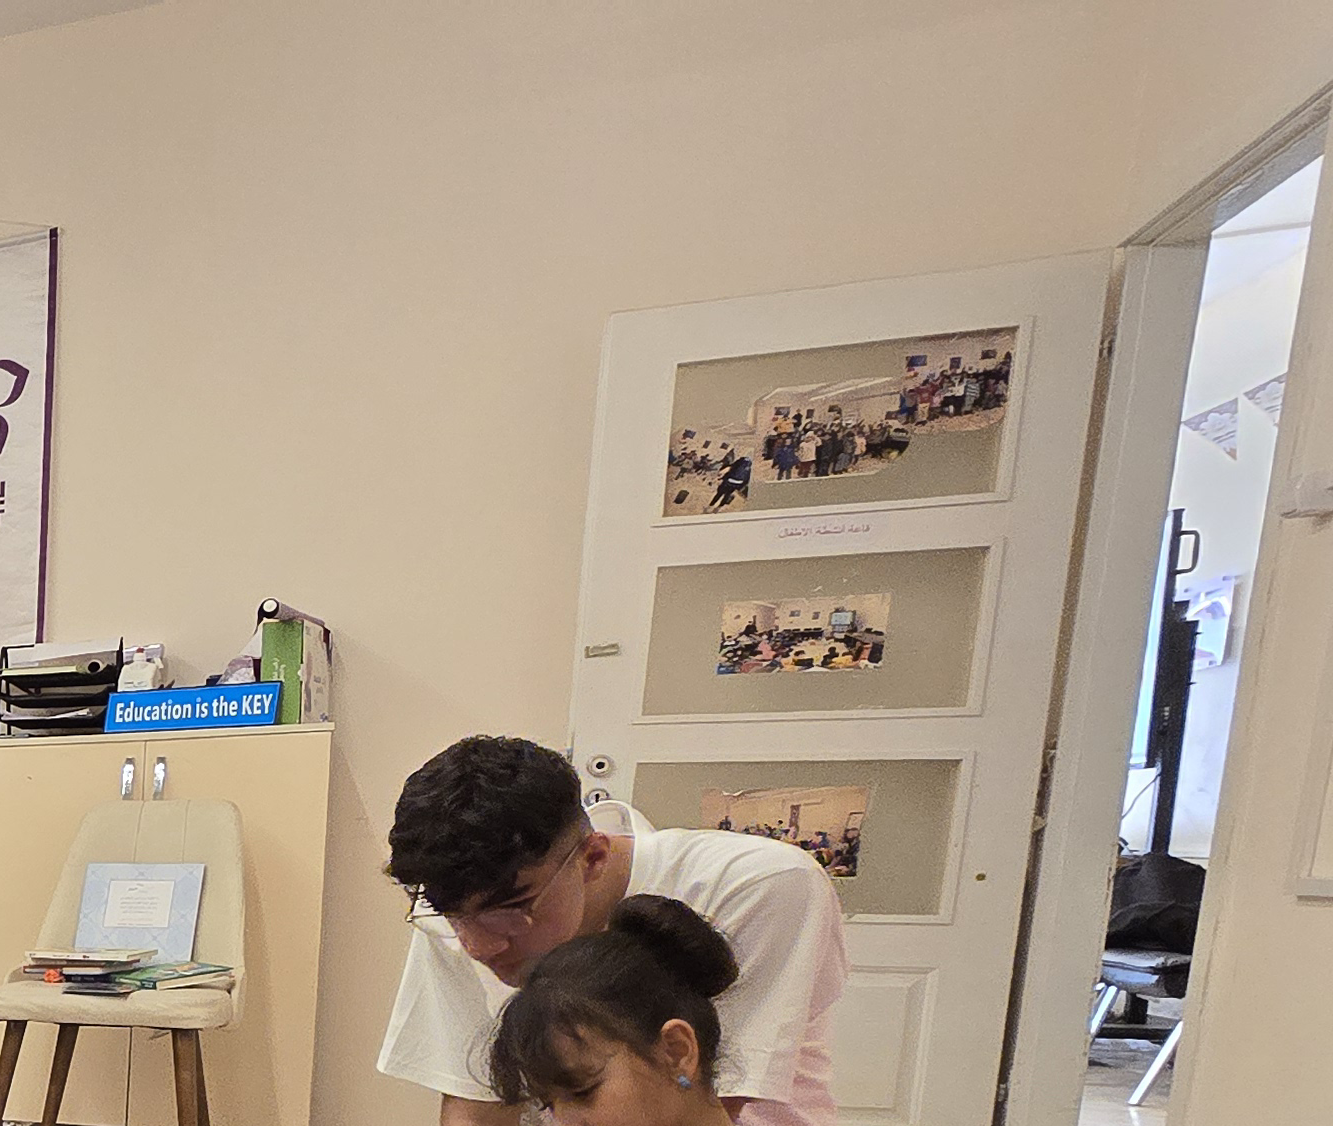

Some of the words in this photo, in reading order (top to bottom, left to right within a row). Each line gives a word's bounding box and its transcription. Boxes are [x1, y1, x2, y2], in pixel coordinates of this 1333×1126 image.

[115, 699, 192, 723] Education
[196, 697, 209, 718] is
[211, 696, 239, 717] the
[242, 694, 274, 715] KEY
